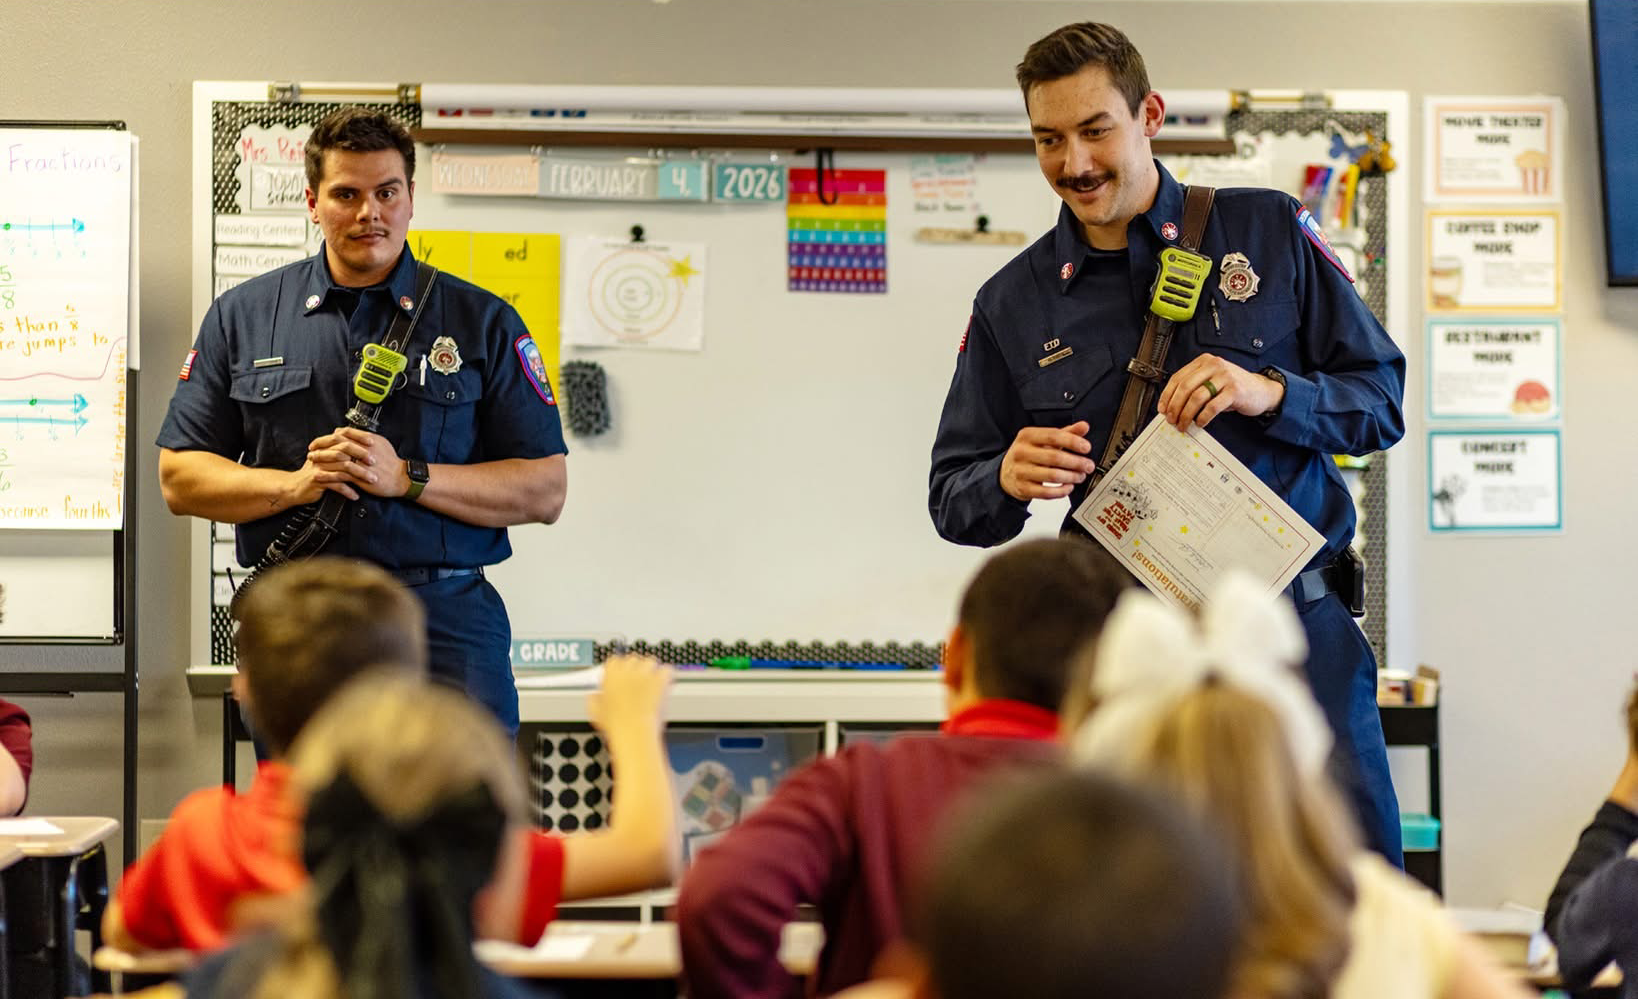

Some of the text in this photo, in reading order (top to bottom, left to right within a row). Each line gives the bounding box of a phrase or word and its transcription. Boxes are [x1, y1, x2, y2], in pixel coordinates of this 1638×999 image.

[8, 143, 120, 173] Fractions
[551, 164, 648, 197] FEBRUARY
[723, 166, 780, 198] 2026
[218, 254, 253, 267] Math
[504, 239, 527, 261] ed
[15, 315, 58, 334] than
[22, 336, 77, 357] jumps
[1131, 550, 1203, 615] gratulations!
[520, 643, 580, 663] GRADE
